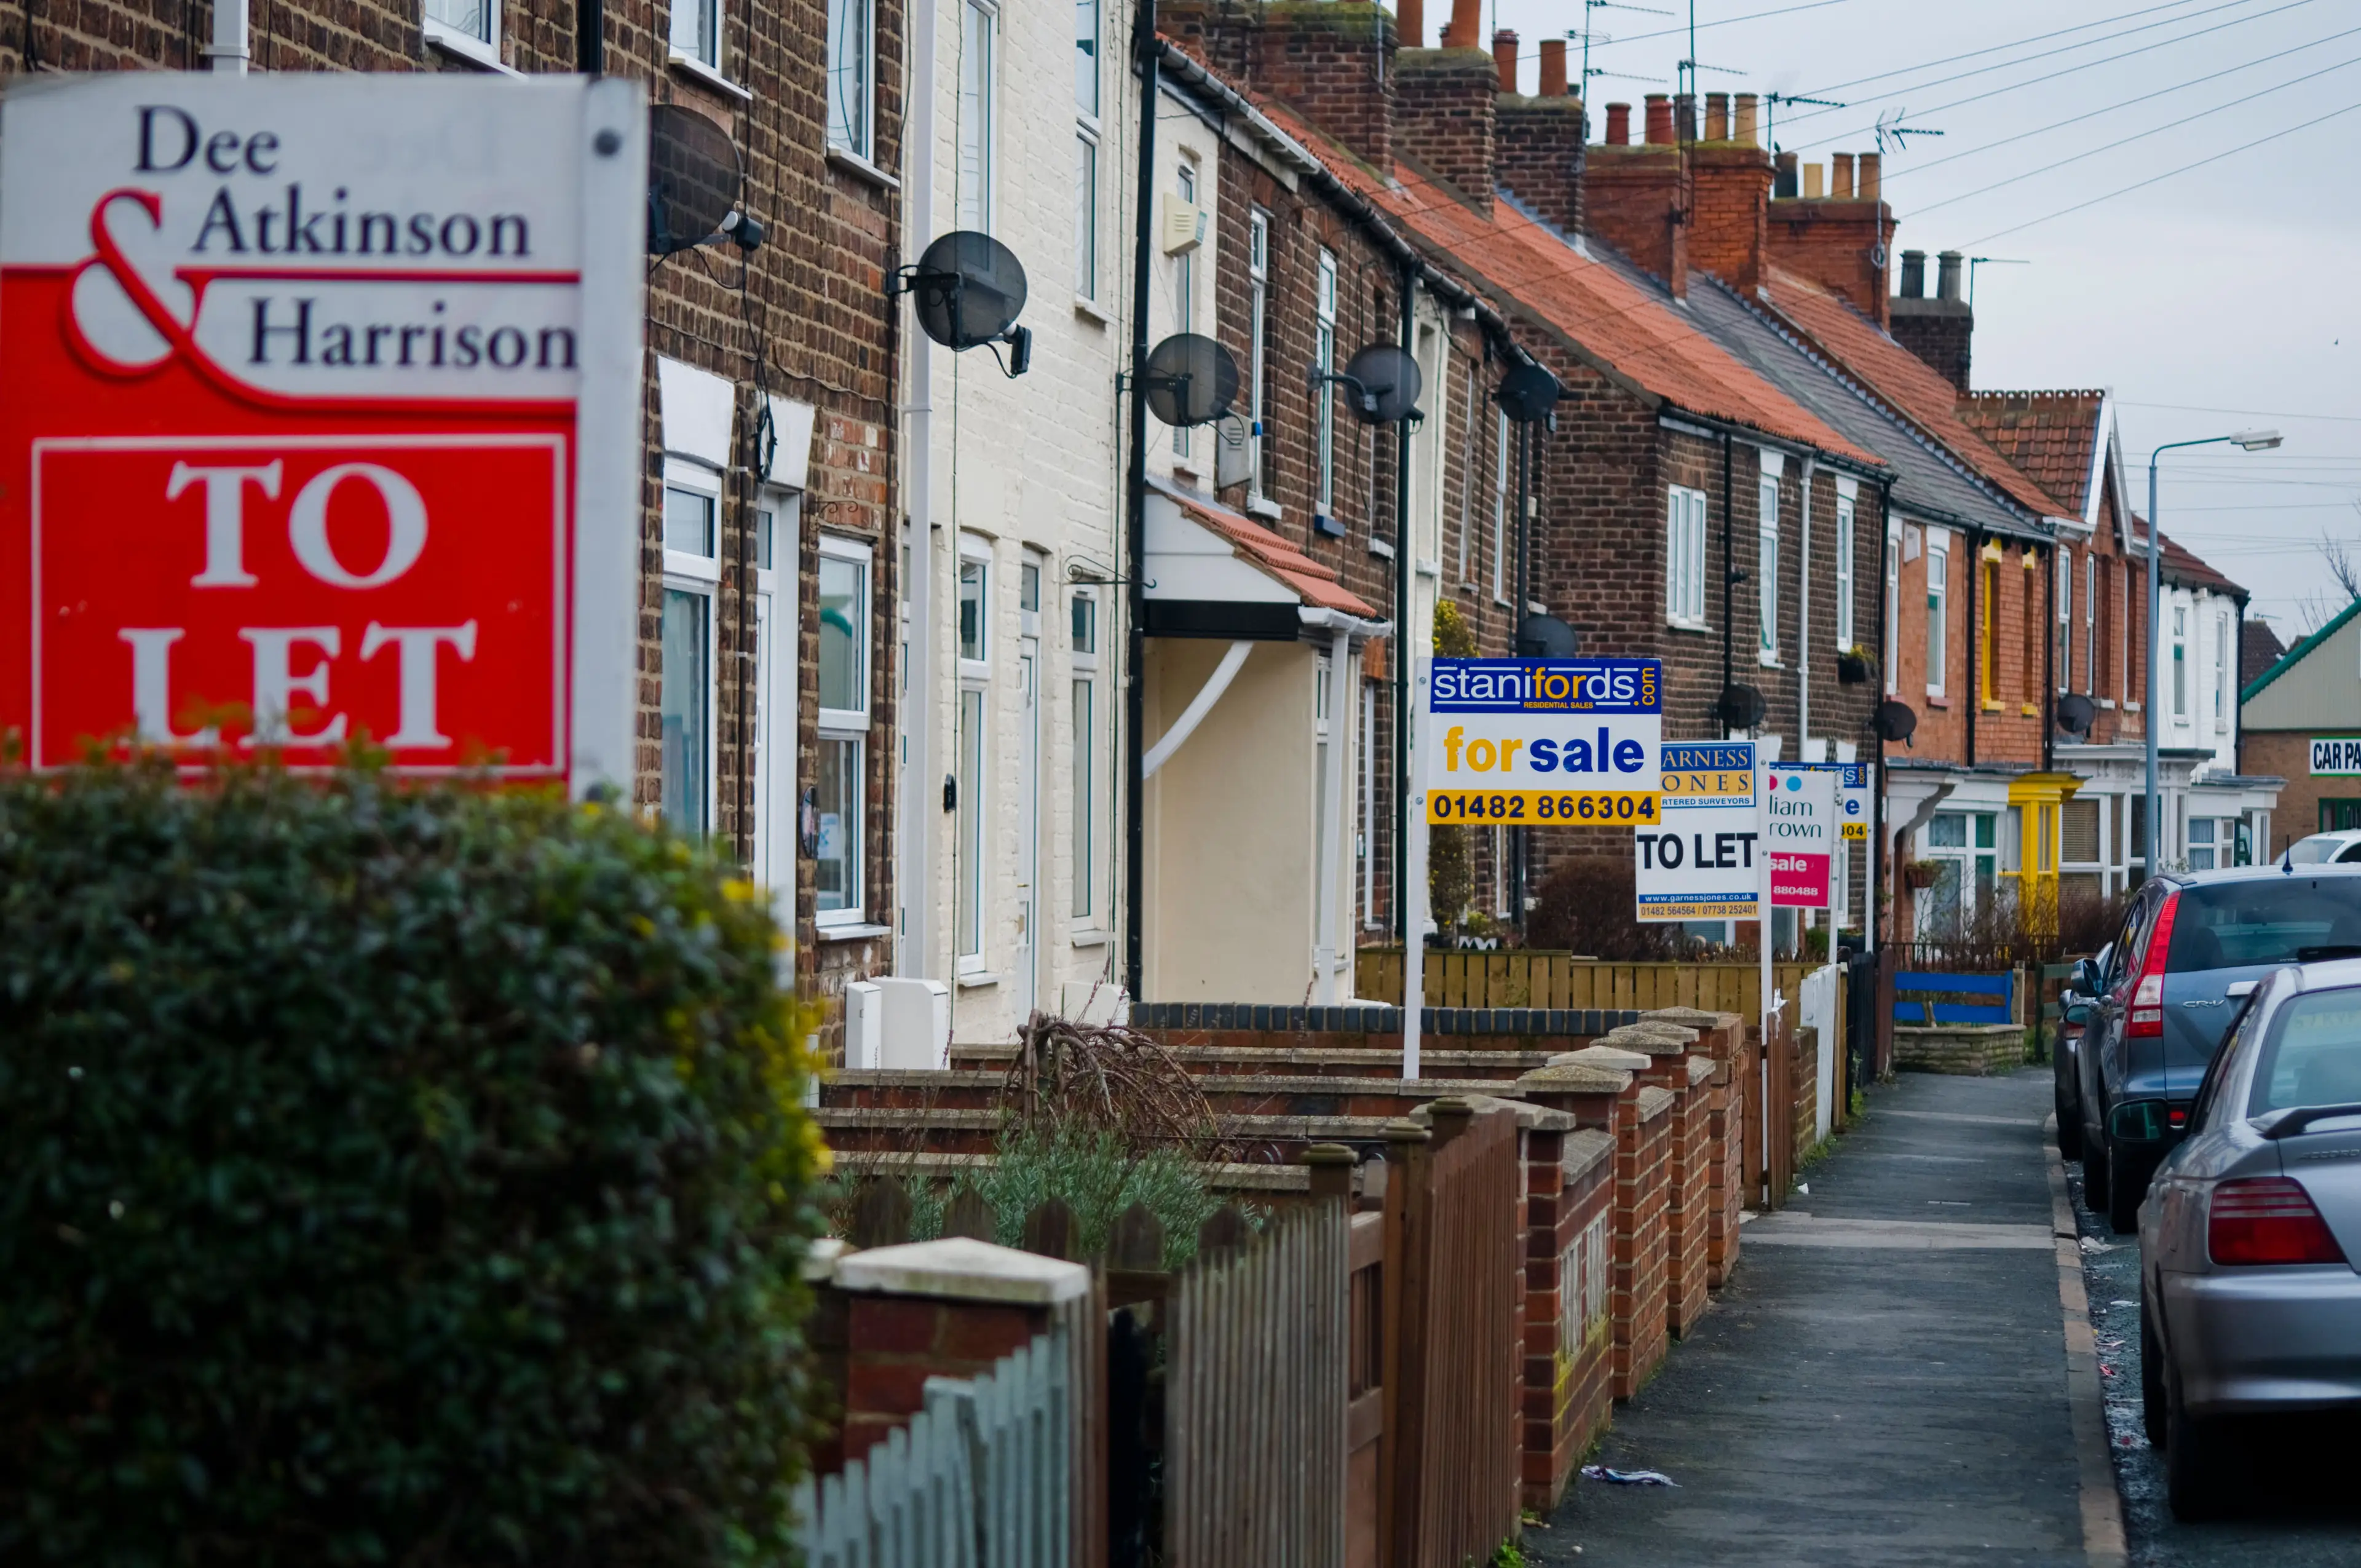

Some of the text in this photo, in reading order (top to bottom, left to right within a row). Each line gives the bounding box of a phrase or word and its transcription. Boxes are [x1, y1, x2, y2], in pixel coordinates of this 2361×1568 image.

[132, 105, 280, 174] Dee
[191, 183, 533, 258] Atkinson
[58, 186, 580, 384] & Harrison
[165, 459, 429, 589] TO
[117, 618, 478, 749] LET
[1434, 667, 1635, 700] stanifords
[1444, 726, 1644, 773] for sale
[1662, 748, 1748, 767] ARNESS
[2314, 742, 2361, 770] CAR PA
[1662, 773, 1749, 792] ONES
[1434, 795, 1655, 819] 01482 866304
[1769, 794, 1813, 817] liam
[1770, 822, 1821, 837] rown
[1637, 833, 1758, 869] TO LET
[1770, 856, 1807, 872] sale
[1641, 906, 1664, 915] 01482
[1667, 905, 1696, 915] 564564
[1703, 905, 1726, 915] 07738
[1728, 905, 1757, 914] 252401
[1645, 893, 1752, 903] www.garnessjones.co.uk
